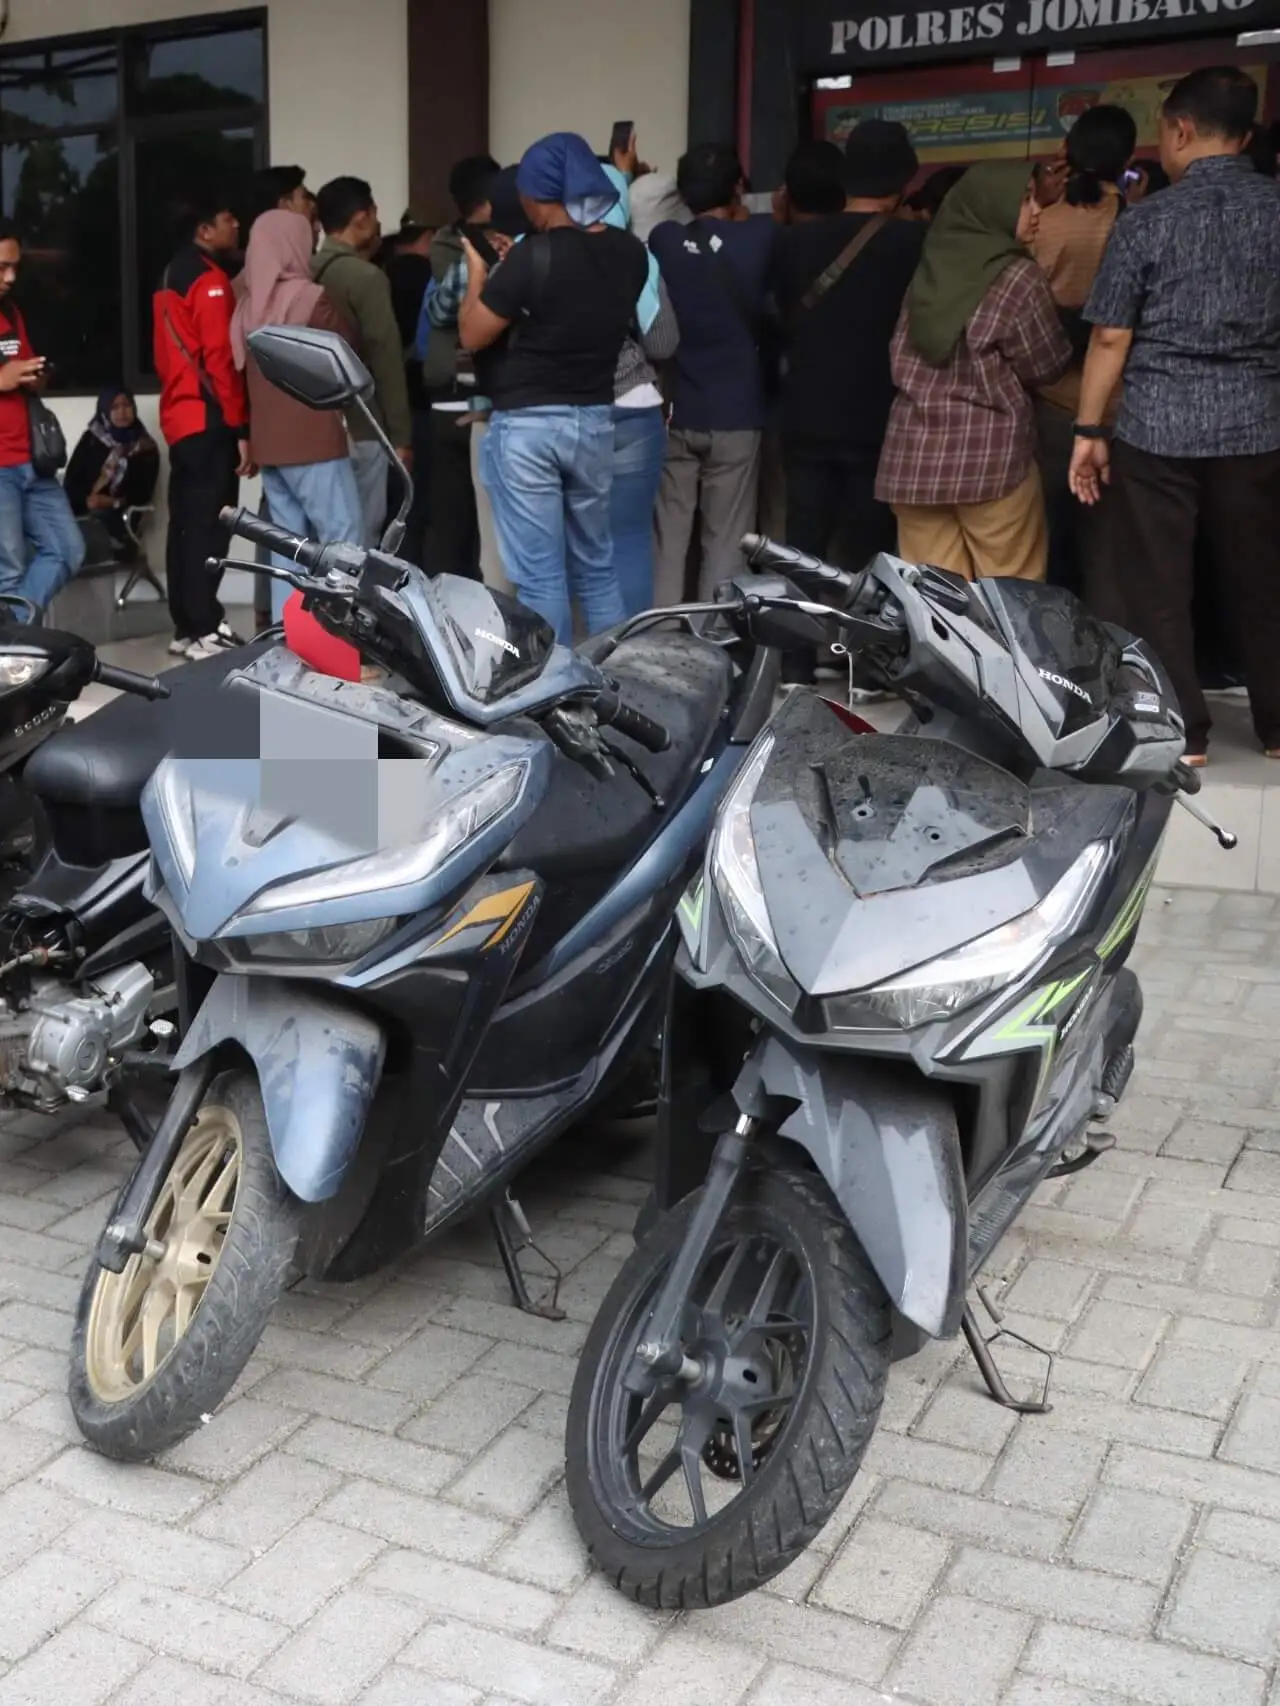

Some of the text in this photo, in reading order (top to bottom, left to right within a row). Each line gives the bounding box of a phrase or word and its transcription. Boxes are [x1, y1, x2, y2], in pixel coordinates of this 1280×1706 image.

[830, 0, 1257, 55] POLRES JOMBA
[475, 628, 520, 659] HONDA
[1038, 667, 1093, 705] HONDA
[499, 896, 541, 956] HONDA
